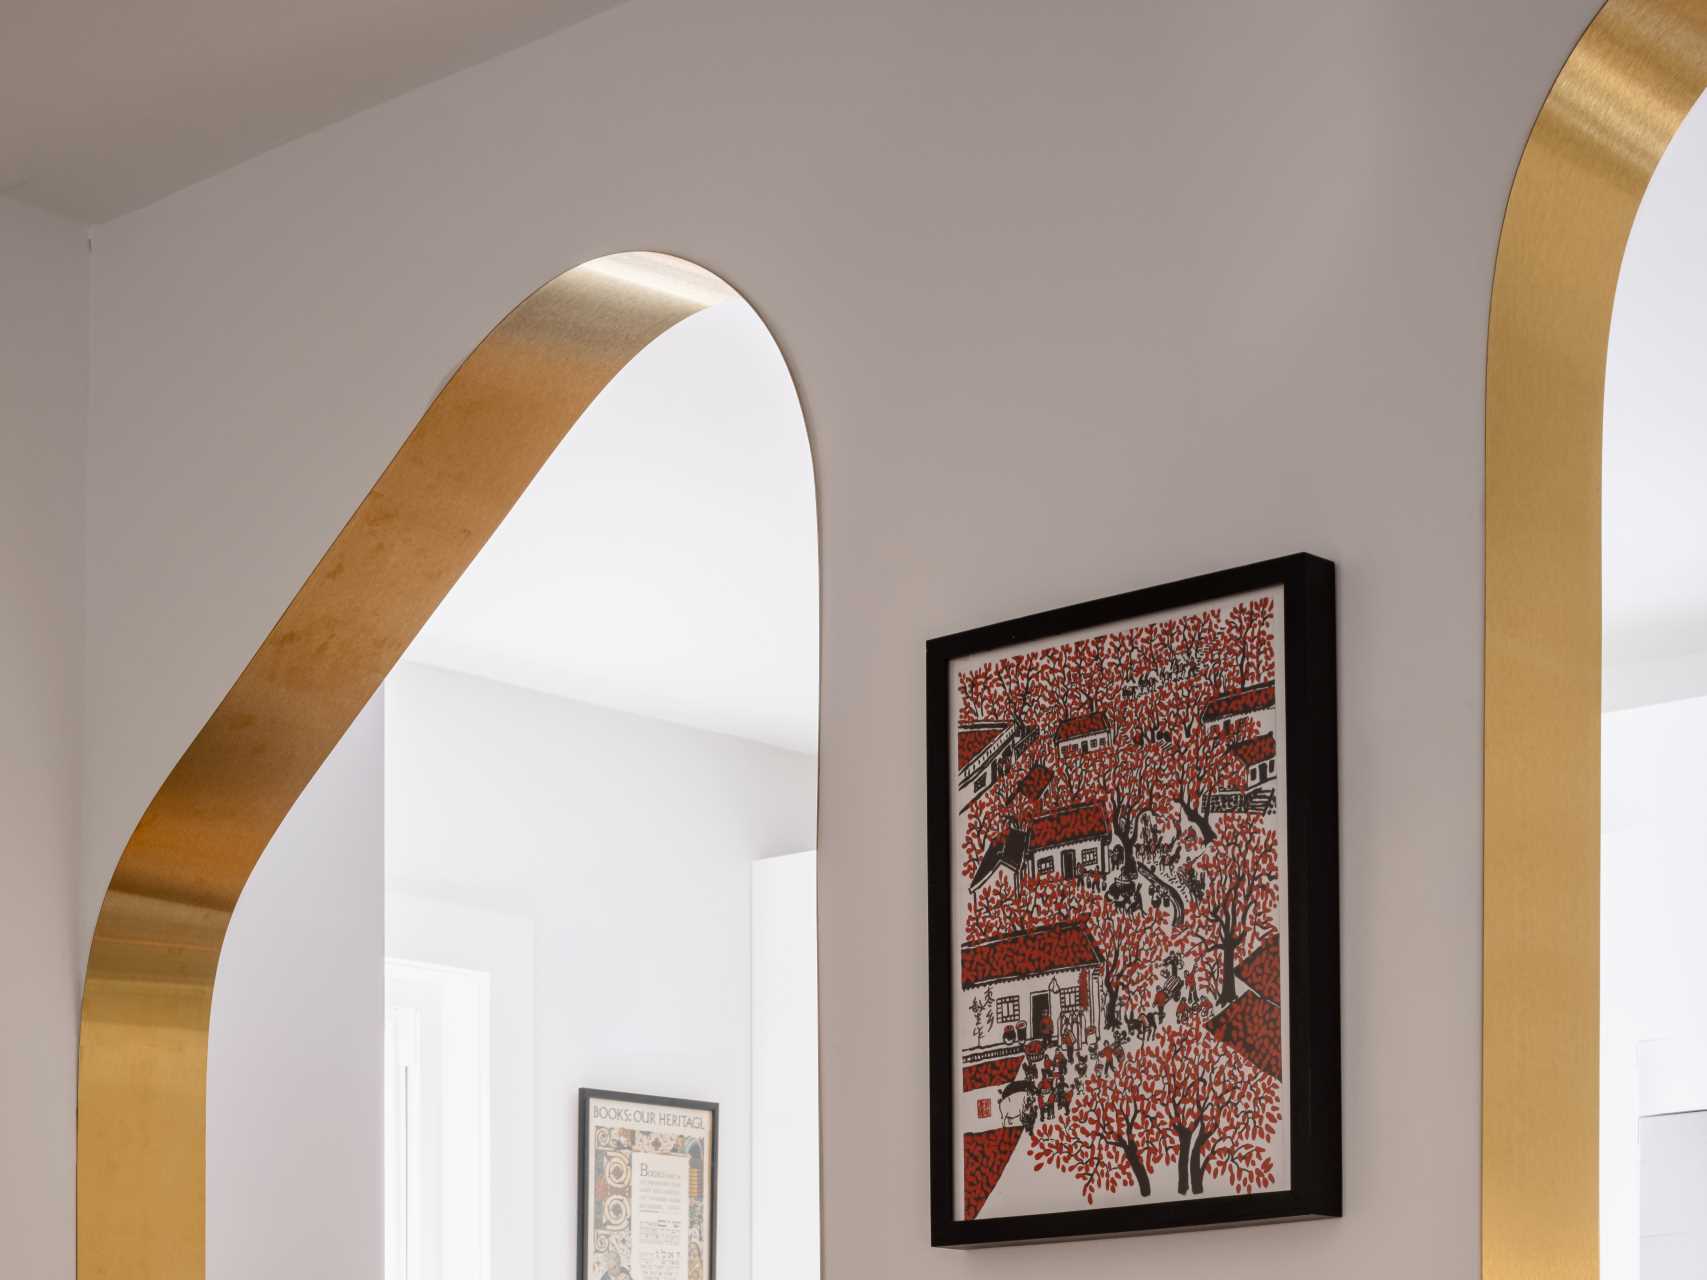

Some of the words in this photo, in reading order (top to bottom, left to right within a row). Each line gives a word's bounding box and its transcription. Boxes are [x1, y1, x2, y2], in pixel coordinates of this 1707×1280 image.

[593, 1104, 631, 1122] BOOKS:
[633, 1110, 657, 1125] OUR
[659, 1112, 705, 1130] HERITAGE
